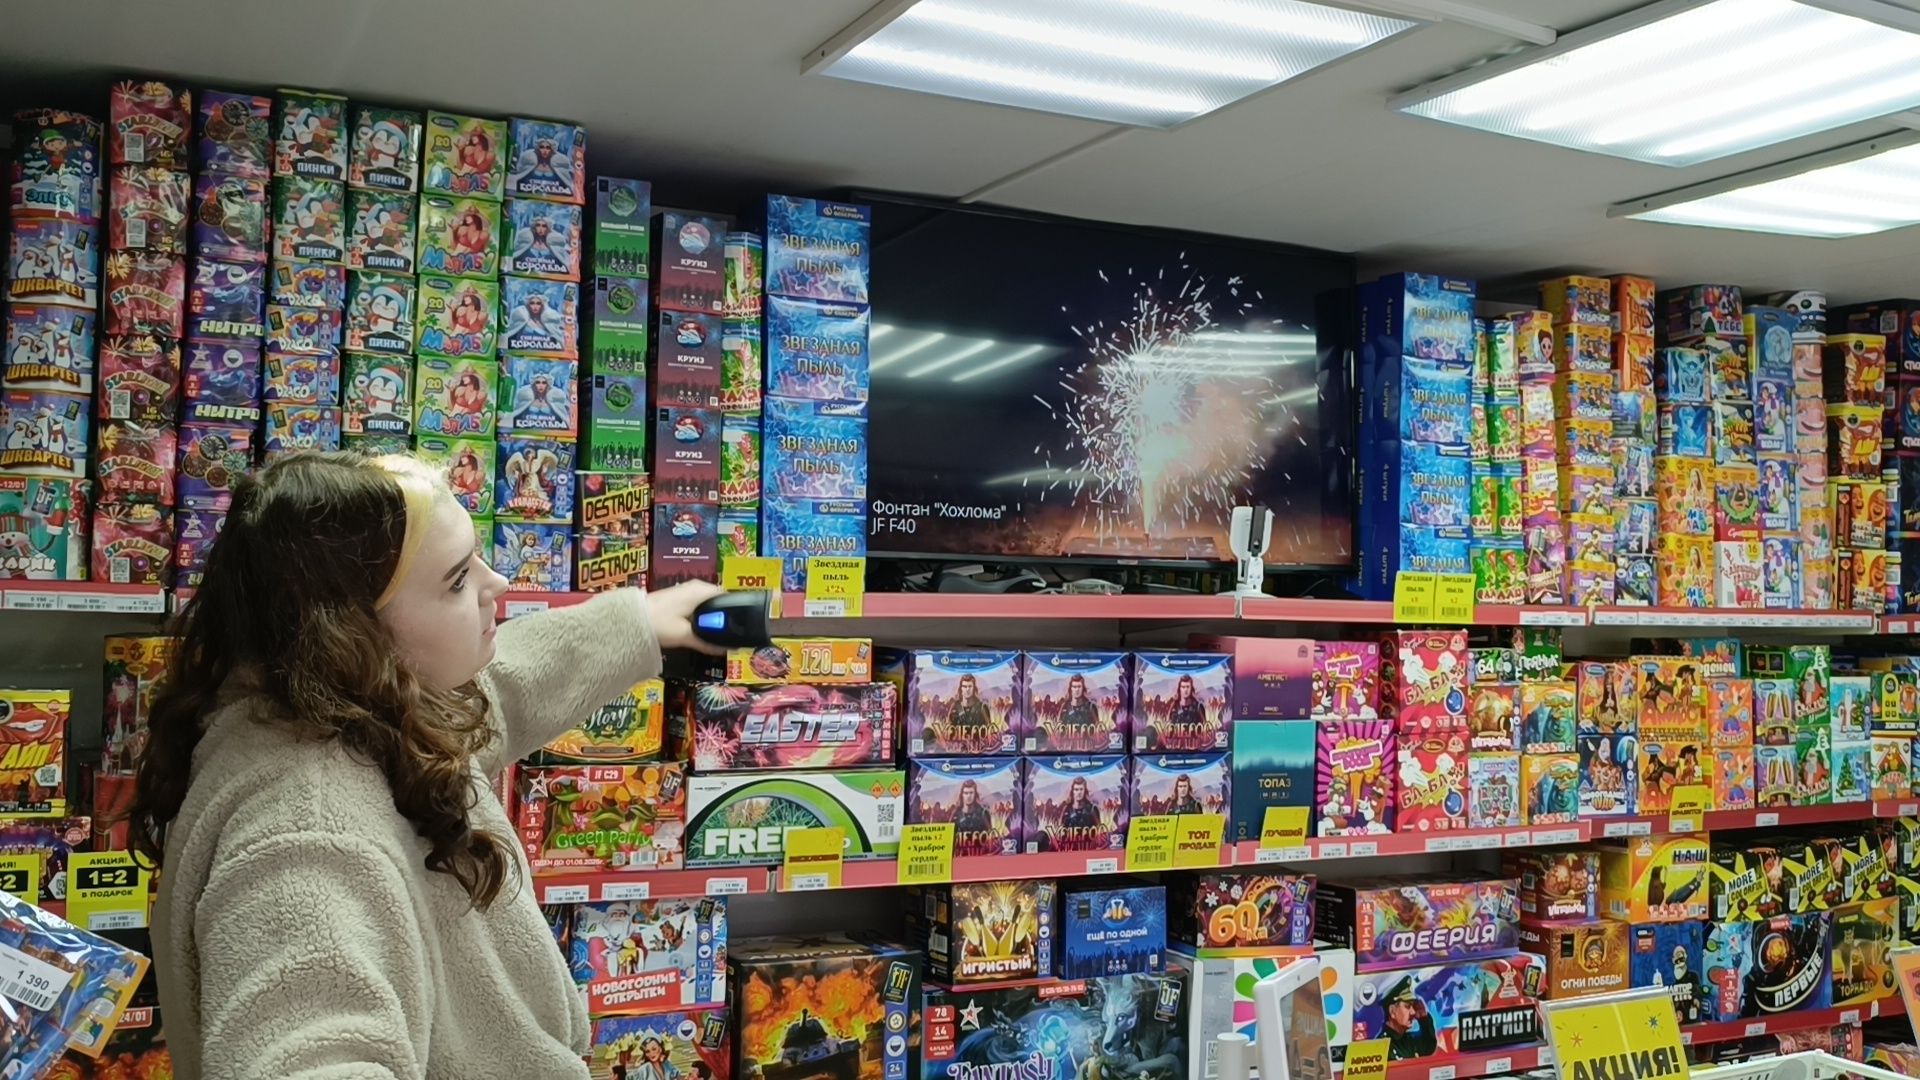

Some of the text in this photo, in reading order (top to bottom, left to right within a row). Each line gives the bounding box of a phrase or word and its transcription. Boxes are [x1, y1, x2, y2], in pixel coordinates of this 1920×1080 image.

[435, 136, 450, 147] 20
[297, 163, 336, 179] ПИНКИ
[369, 174, 406, 190] ПИНКИ
[299, 245, 337, 260] ПИНКИ
[781, 232, 861, 257] ЗВЕЗДНАЯ
[367, 257, 405, 272] ПИНКИ
[681, 258, 708, 269] КРУИЗ
[795, 258, 842, 275] ПЫЛЬ
[10, 278, 86, 300] ШКВАРТЕТ
[429, 297, 444, 308] 20
[1414, 305, 1469, 324] ЗВЕЗДНАЯ
[368, 335, 406, 351] ПИНКИ
[781, 334, 861, 358] ЗВЕЗДНАЯ
[677, 354, 705, 364] КРУИЗ
[5, 364, 82, 386] ШКВАРТЕТ
[796, 358, 843, 377] ПЫЛЬ
[426, 377, 441, 389] 20
[1411, 387, 1467, 405] ЗВЕЗДНАЯ
[367, 420, 405, 435] ПИНКИ
[777, 434, 858, 455] ЗВЕЗДНАЯ
[0, 449, 76, 471] ШКВАРТЕТ
[675, 450, 703, 459] КРУИЗ
[792, 458, 842, 475] ПЫЛЬ
[1410, 472, 1467, 488] ЗВЕЗДНАЯ
[872, 500, 1007, 520] Фонтан "Хохлома"
[871, 518, 915, 535] JF F40
[672, 546, 701, 555] КРУИЗ
[777, 534, 857, 554] ЗВЕЗДНАЯ
[1747, 543, 1758, 553] 16
[814, 560, 860, 570] Звездная
[1409, 555, 1465, 571] ЗВЕЗДНАЯ
[737, 576, 766, 587] ТОП
[799, 648, 832, 676] 120
[1477, 659, 1494, 675] 64
[741, 711, 860, 745] EASTER
[1258, 778, 1292, 792] ТОПАЗ
[555, 829, 656, 851] Green Party
[1188, 830, 1211, 840] ТОП
[1264, 826, 1304, 840] ЛУЧШИЙ
[912, 843, 946, 853] Храброе
[1178, 841, 1217, 852] ПРОДАЖ
[89, 857, 128, 866] АКЦИЯ!
[909, 853, 939, 864] сердце
[1853, 852, 1876, 873] MORE
[88, 869, 127, 886] 1=2
[1800, 863, 1822, 884] MORE
[1728, 871, 1753, 893] MORE
[90, 889, 134, 898] ПОДАРОК
[1208, 900, 1260, 944] 60
[1086, 926, 1149, 942] ЕЩЁ ПО ОДНОЙ
[1390, 924, 1498, 954] ФЕЕРИЯ
[962, 953, 1033, 976] ИГРИСТЫЙ
[26, 975, 50, 991] 390
[591, 971, 677, 997] НОВОГОДНИЕ
[1561, 973, 1623, 990] ОГНИ ПОБЕДЫ
[1774, 954, 1824, 1008] ПЕРВЫЕ
[1840, 979, 1875, 997] ТОРНАДО
[602, 986, 667, 1006] ОТКРЫТКИ
[934, 1007, 948, 1018] 78
[934, 1026, 947, 1036] 14
[1461, 1008, 1535, 1042] ПАТРИОТ
[946, 1050, 1056, 1080] FANTASY
[1350, 1053, 1383, 1066] МНОГО
[1572, 1045, 1681, 1080] АКЦИЯ!
[889, 1063, 900, 1074] 24
